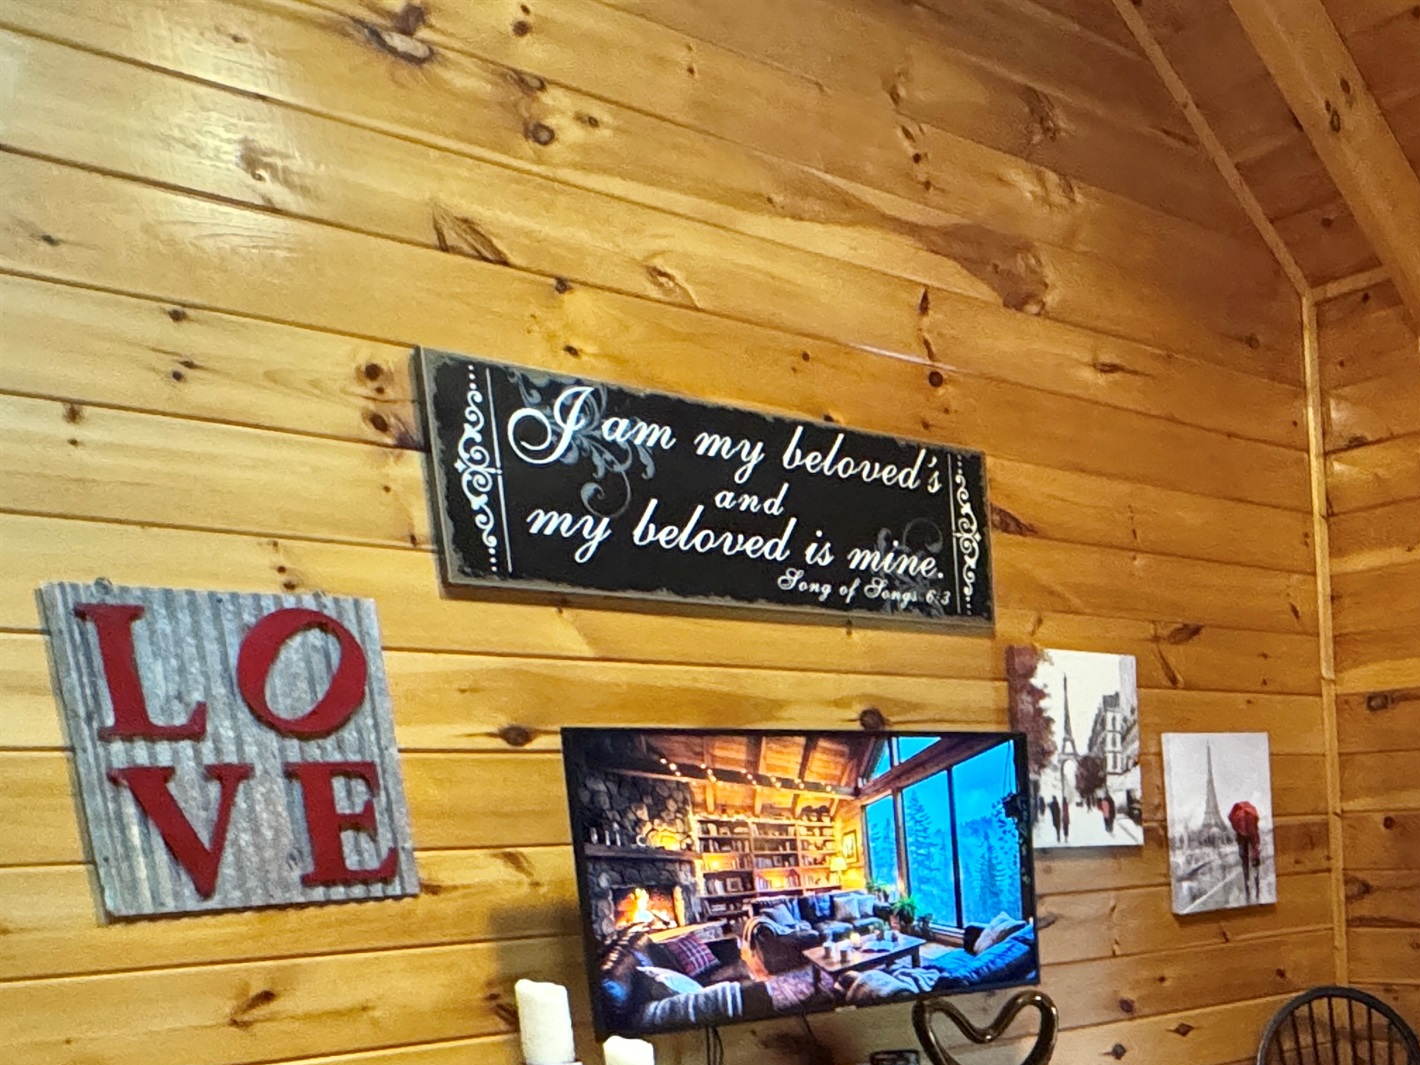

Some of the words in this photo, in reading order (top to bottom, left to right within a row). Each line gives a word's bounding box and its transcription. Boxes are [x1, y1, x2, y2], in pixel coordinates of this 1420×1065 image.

[507, 386, 595, 465] I
[601, 416, 677, 450] am
[694, 432, 765, 484] my
[782, 425, 942, 493] beloved's
[715, 482, 789, 516] and
[526, 509, 612, 563] my
[633, 498, 797, 562] beloved
[805, 530, 834, 566] is
[847, 540, 944, 579] mine.
[777, 567, 831, 601] Song
[839, 577, 861, 604] of
[864, 577, 917, 609] Songs
